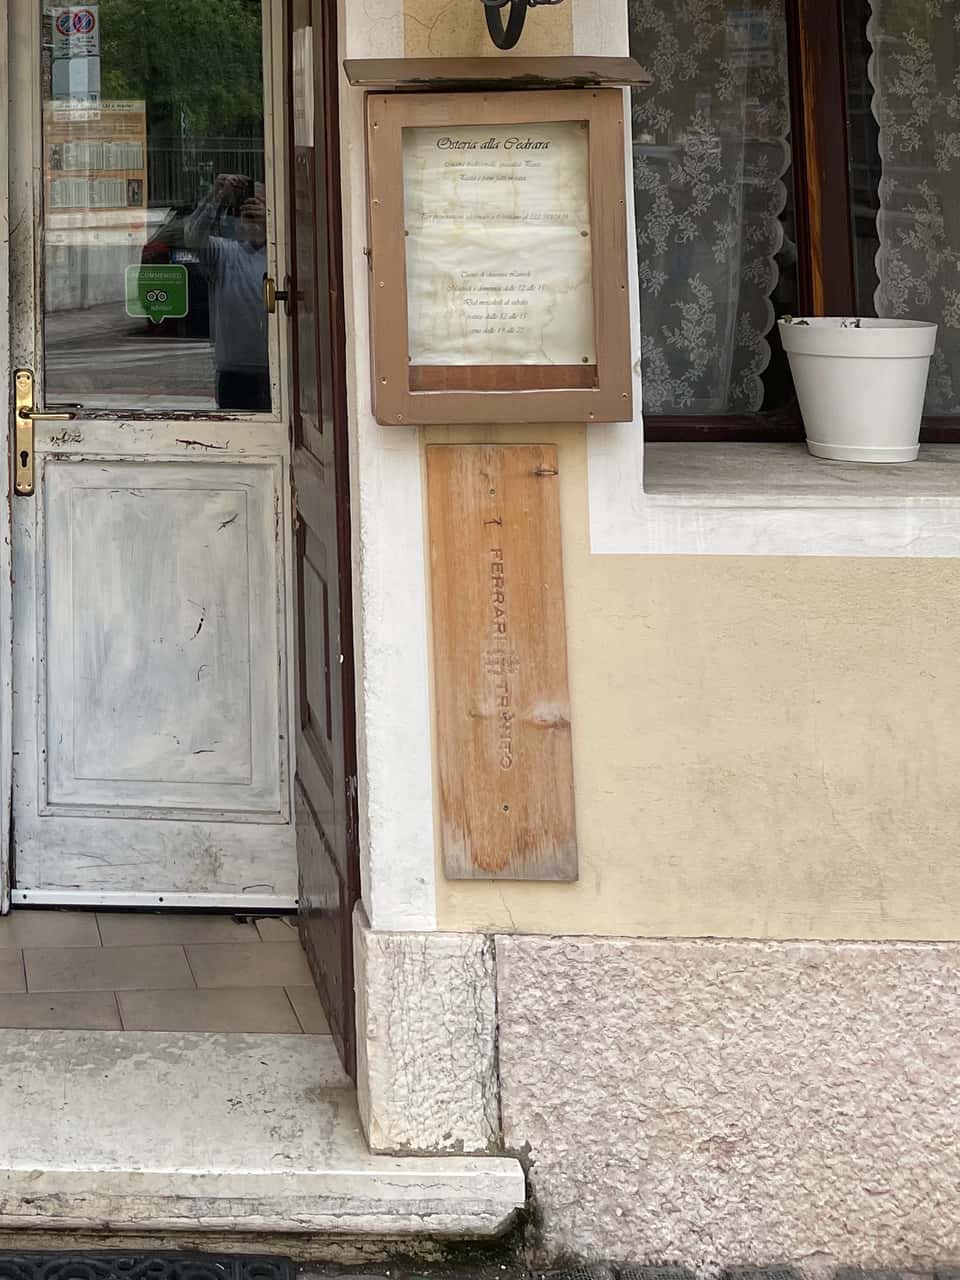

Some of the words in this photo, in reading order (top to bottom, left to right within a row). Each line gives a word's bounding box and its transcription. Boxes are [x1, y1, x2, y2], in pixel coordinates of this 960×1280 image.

[436, 137, 476, 150] Osteria
[480, 138, 498, 150] alla
[503, 137, 551, 150] Cedrara
